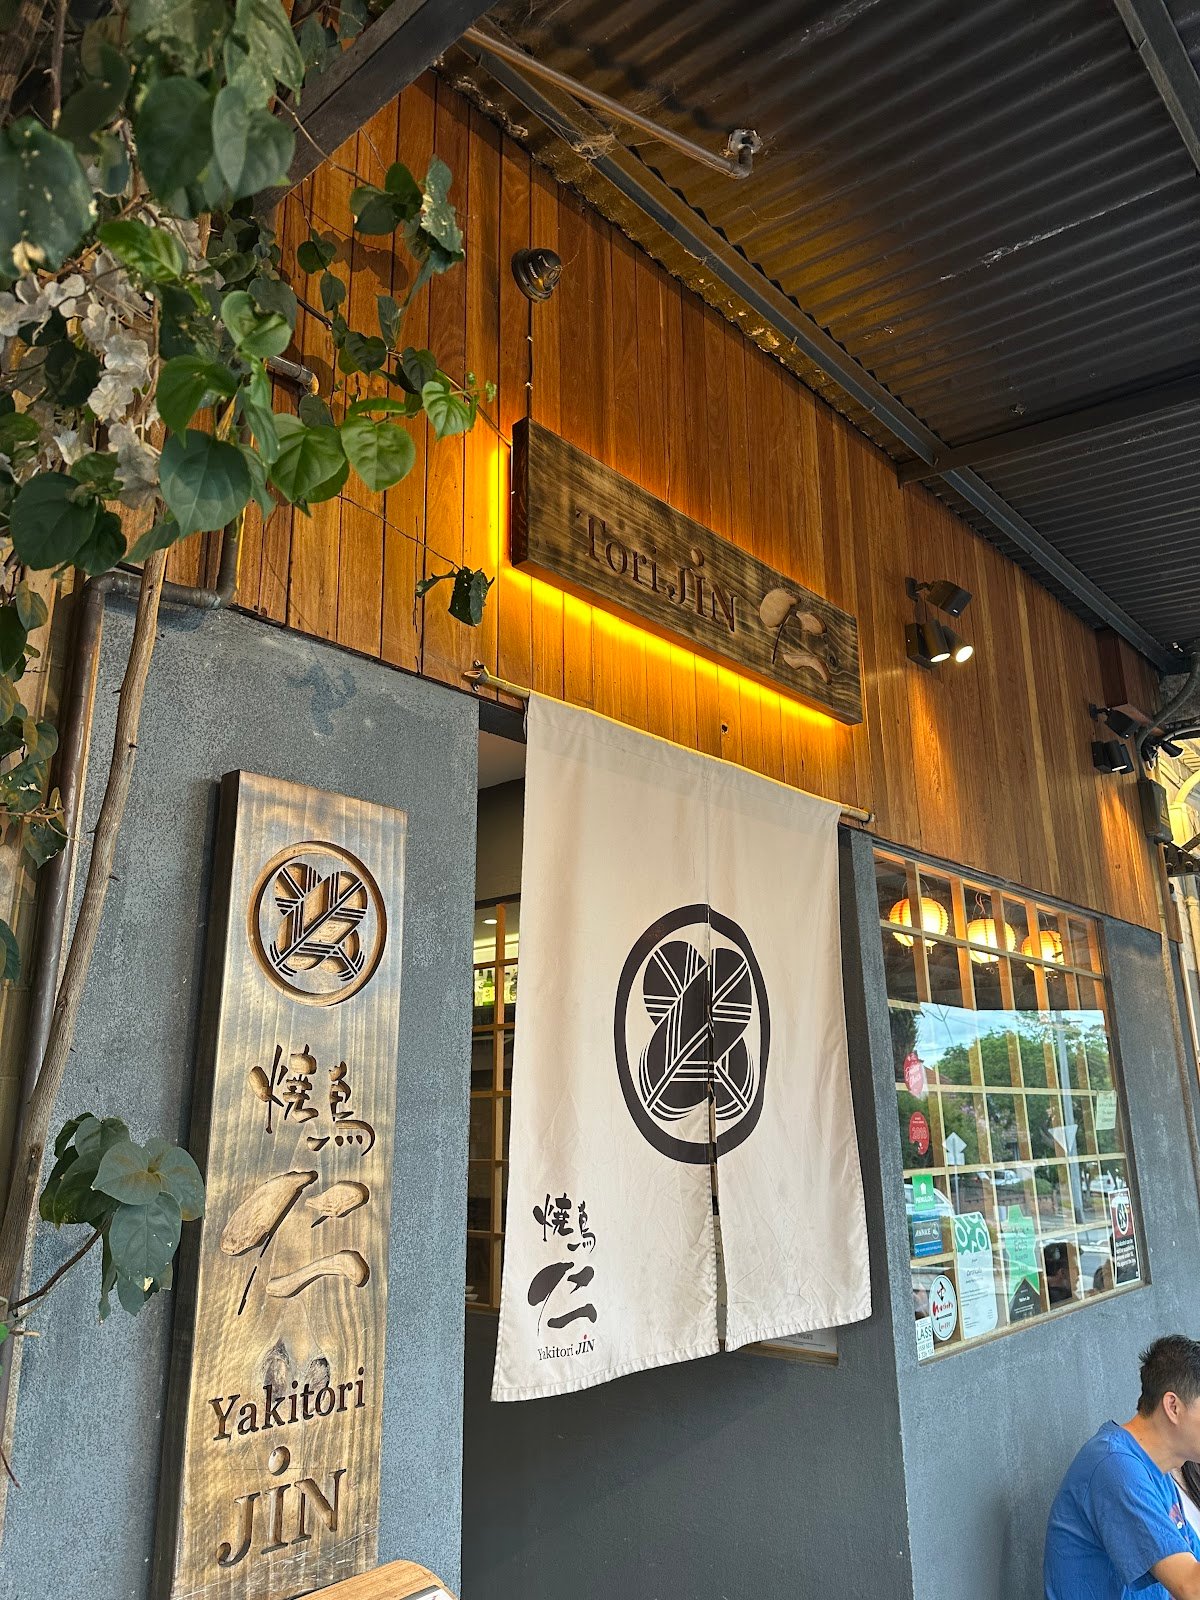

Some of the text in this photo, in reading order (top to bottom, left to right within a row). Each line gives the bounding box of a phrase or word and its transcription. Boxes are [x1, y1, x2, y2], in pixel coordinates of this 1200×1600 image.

[575, 509, 660, 595] Tori
[537, 1343, 574, 1361] Yakitori
[208, 1366, 366, 1441] Yakitori
